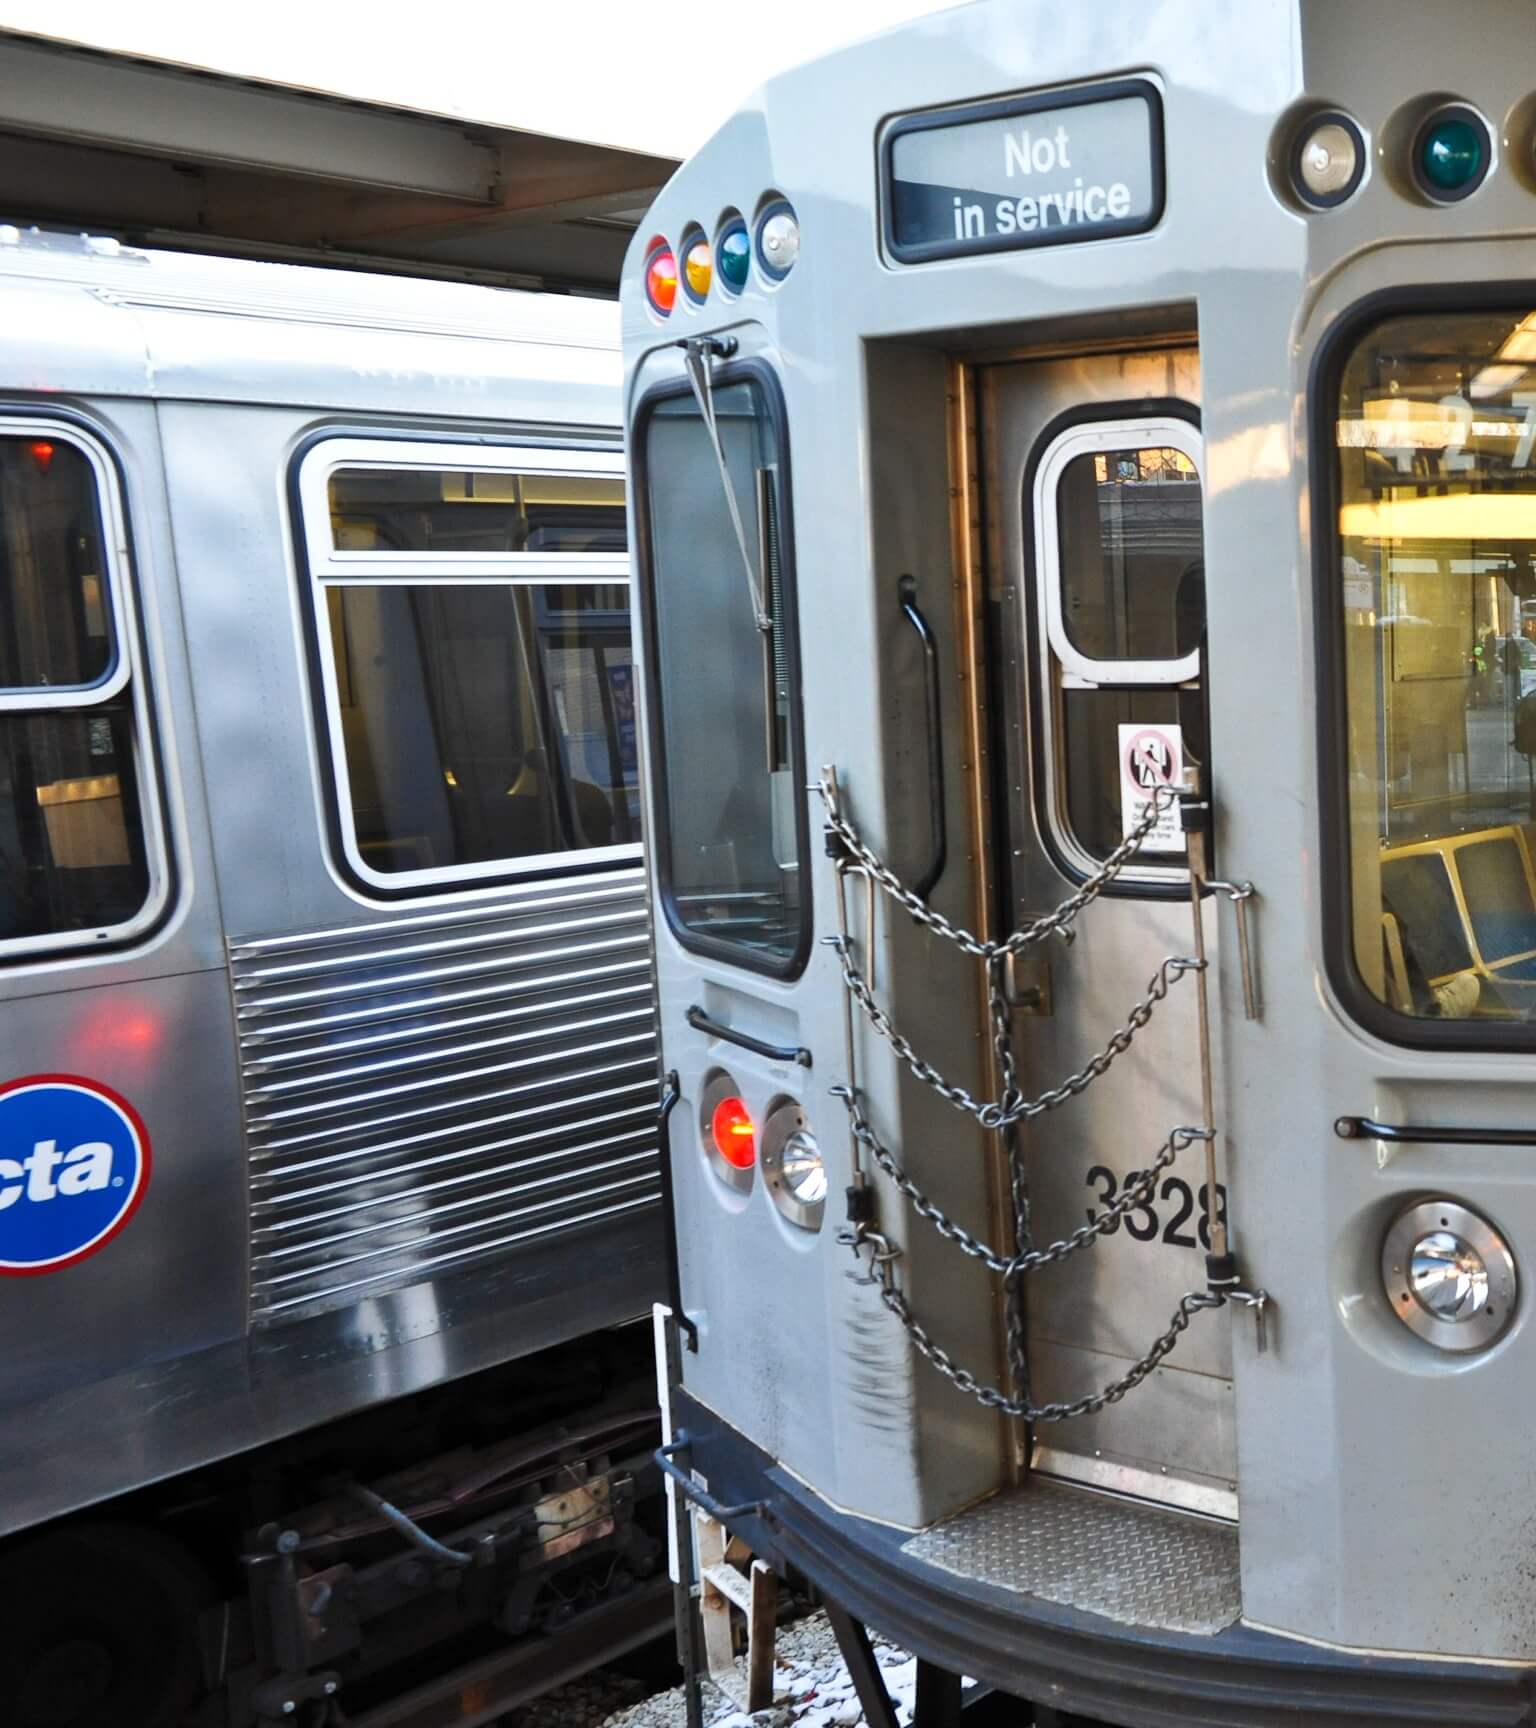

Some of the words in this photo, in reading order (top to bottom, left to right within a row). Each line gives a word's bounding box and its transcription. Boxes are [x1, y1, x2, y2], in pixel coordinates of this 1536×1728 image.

[1003, 125, 1071, 177] Not
[953, 197, 985, 240] in
[996, 176, 1131, 235] service
